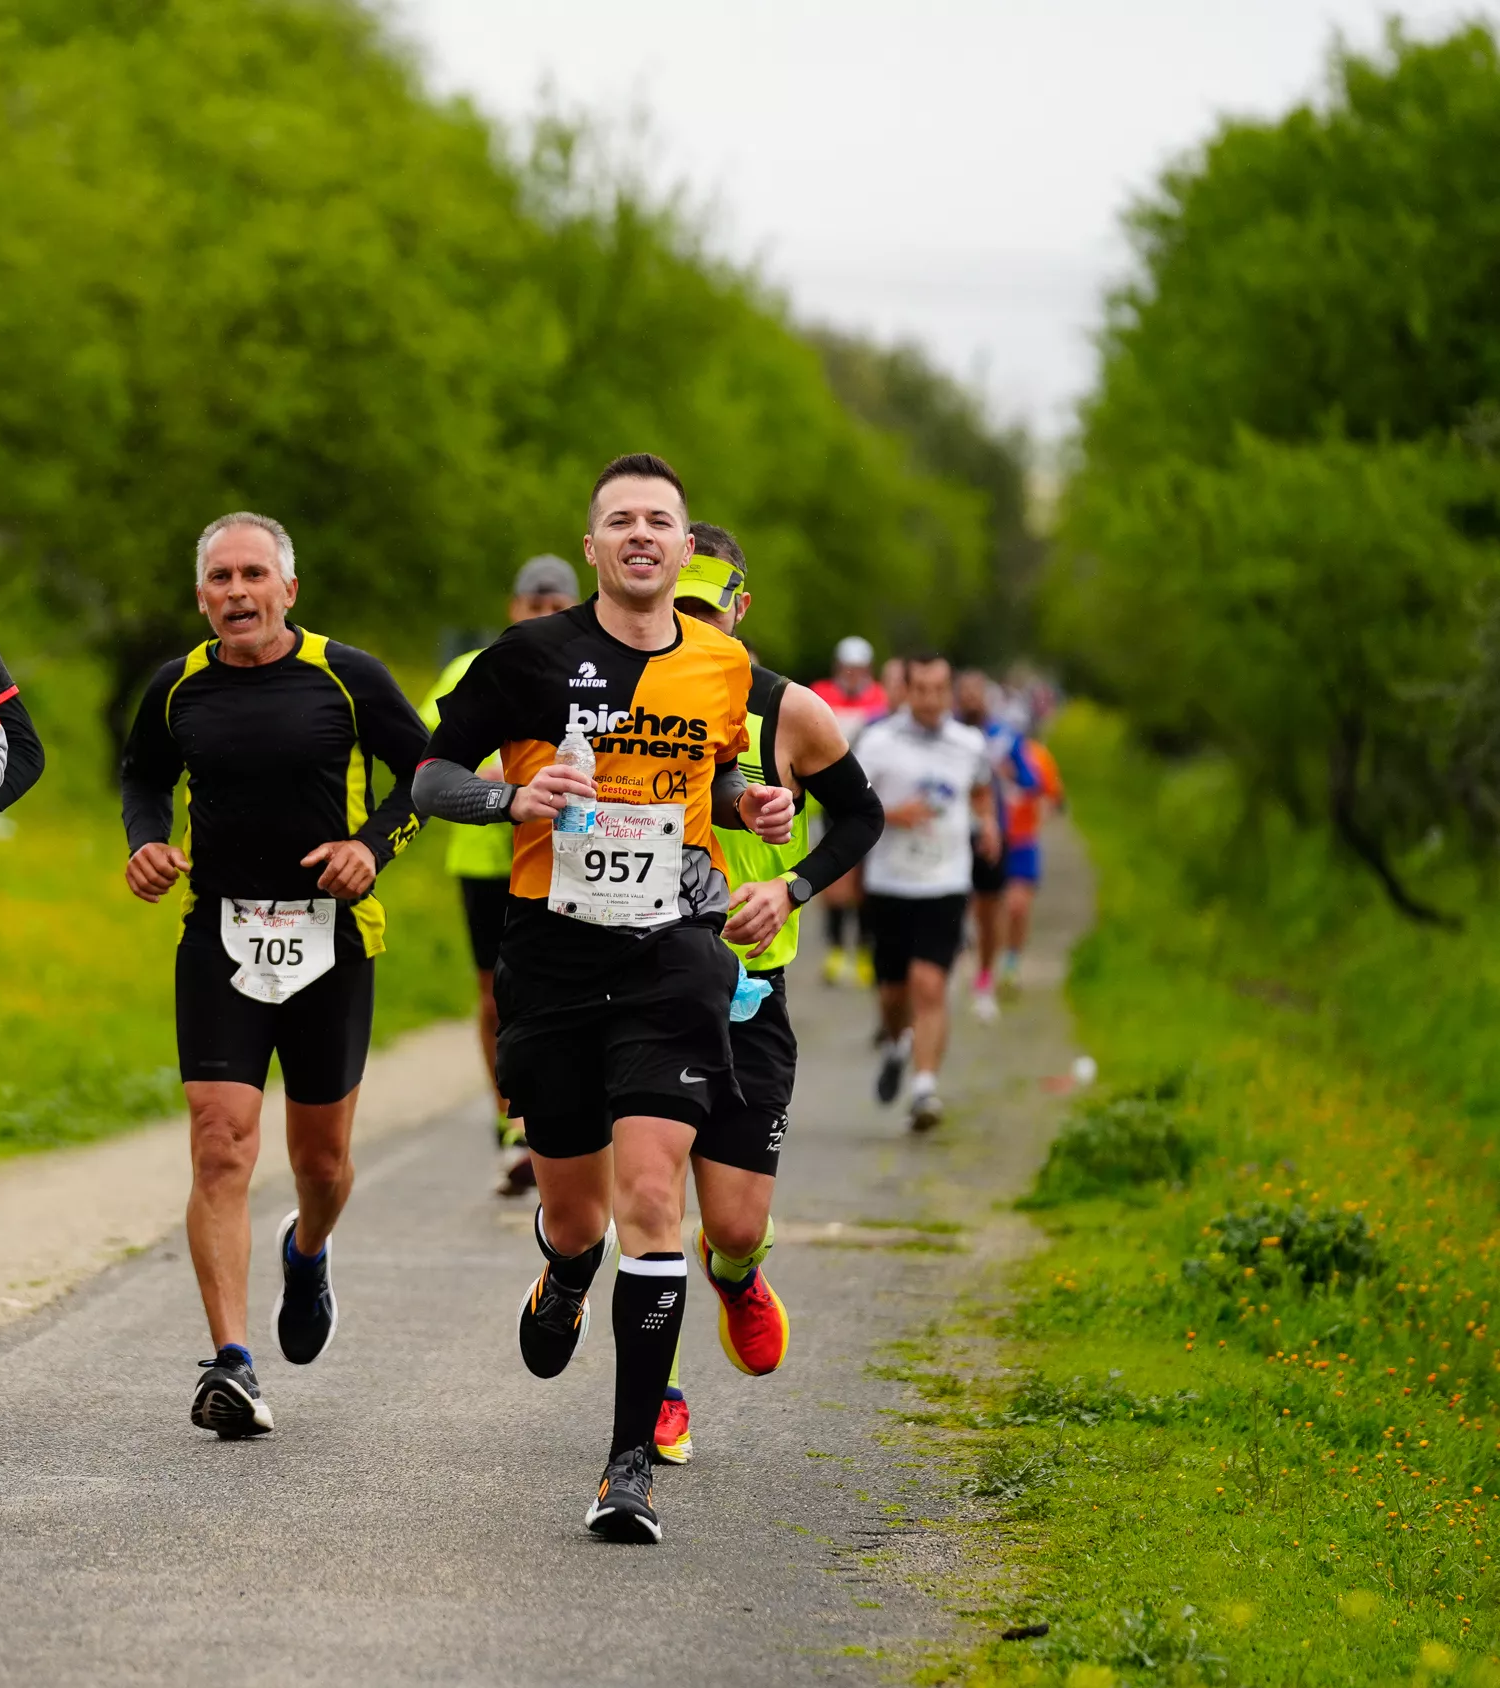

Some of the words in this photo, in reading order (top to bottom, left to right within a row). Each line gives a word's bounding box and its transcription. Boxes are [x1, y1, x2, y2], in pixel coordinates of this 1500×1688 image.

[569, 678, 608, 688] VIATOR
[569, 703, 708, 741] bichos
[586, 736, 705, 761] unners
[592, 773, 612, 783] egio
[615, 775, 644, 786] Oficial
[601, 784, 642, 797] Gestores
[605, 825, 647, 839] LUCENA
[585, 850, 654, 883] 957
[249, 938, 304, 966] 705
